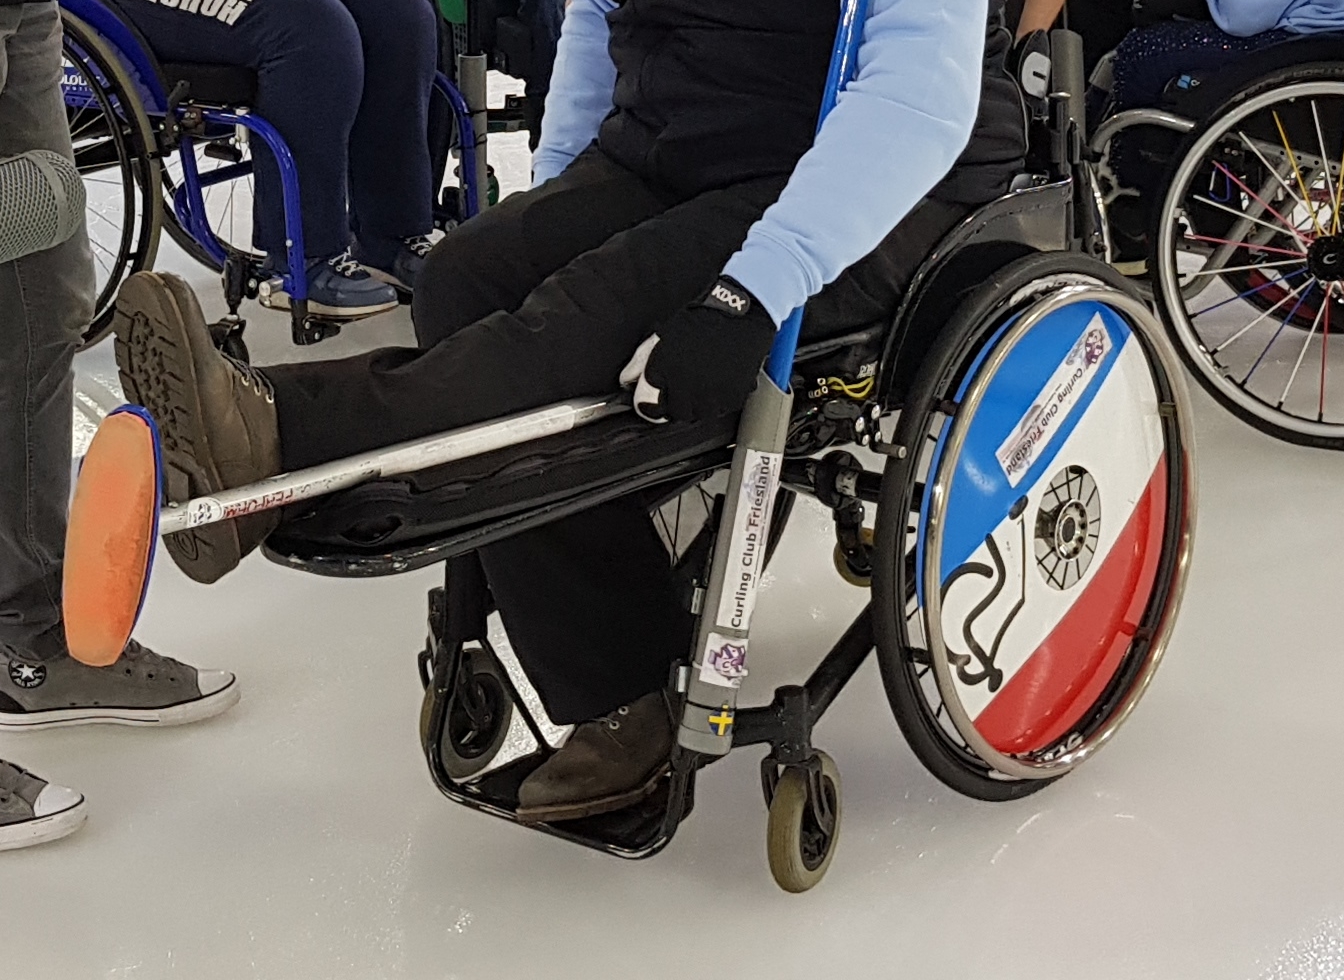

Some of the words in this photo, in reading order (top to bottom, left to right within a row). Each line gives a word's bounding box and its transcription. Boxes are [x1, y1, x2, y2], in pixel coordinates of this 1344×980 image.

[711, 284, 746, 311] KIXX
[1056, 367, 1084, 404] Curling
[1041, 404, 1059, 427] Club
[1006, 428, 1045, 476] Friesland
[749, 456, 770, 528] Friesland
[742, 532, 757, 567] Club
[731, 572, 752, 628] Curling
